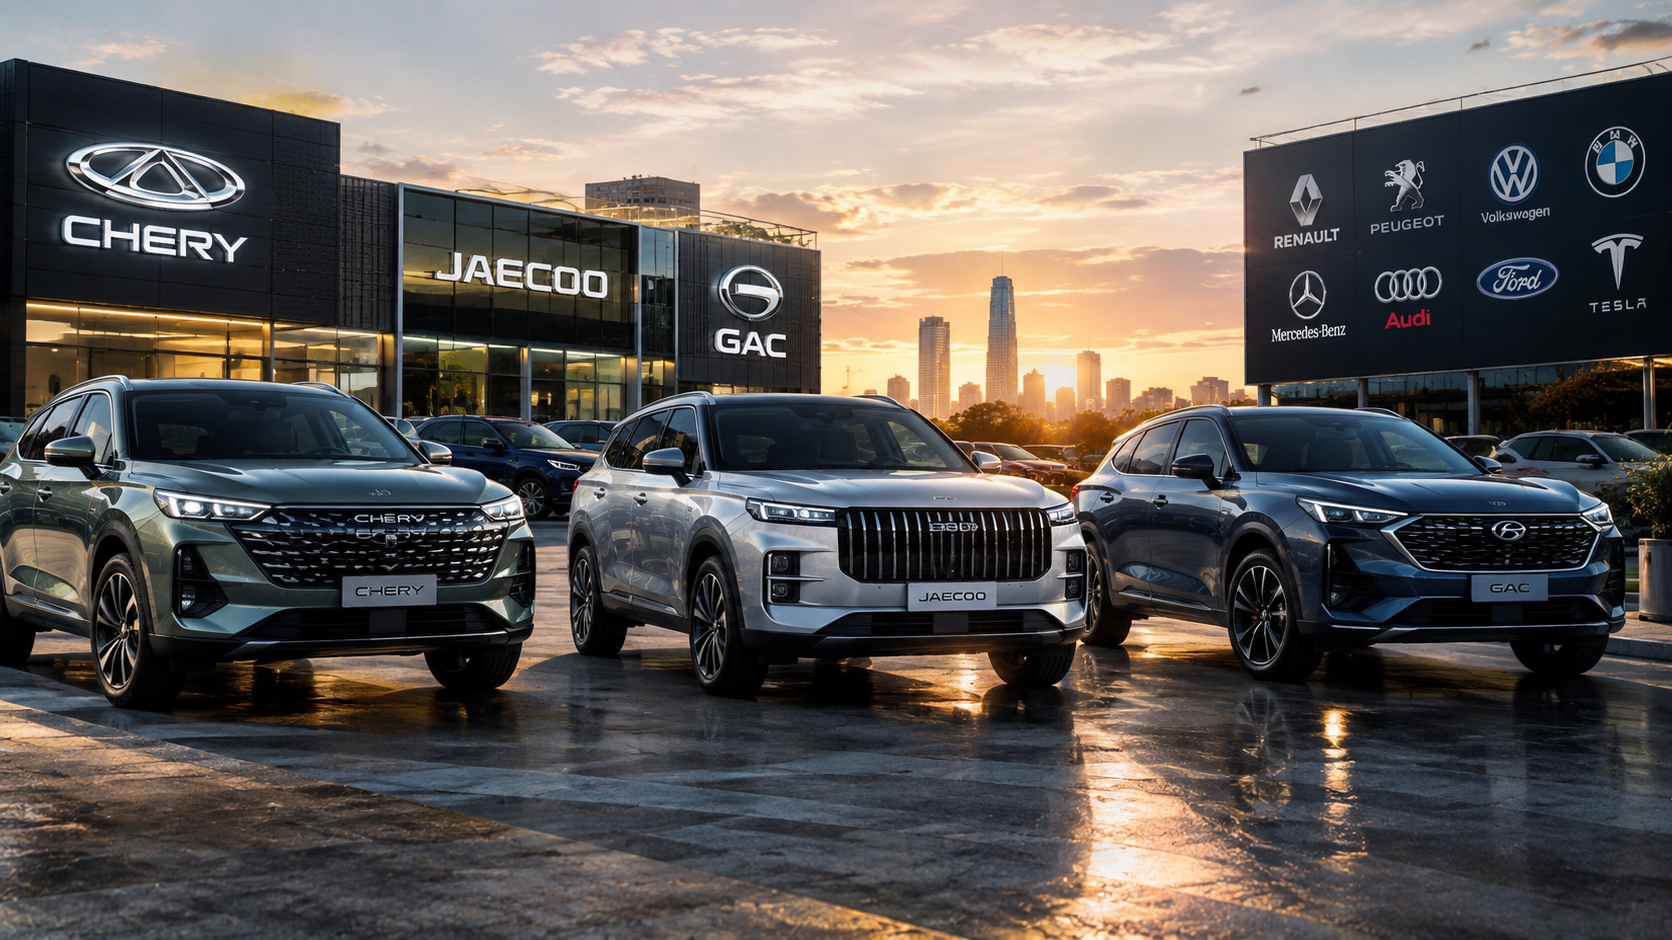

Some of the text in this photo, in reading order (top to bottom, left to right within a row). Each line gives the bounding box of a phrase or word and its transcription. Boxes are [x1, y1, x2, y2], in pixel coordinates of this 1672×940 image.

[1370, 215, 1445, 234] PEUGEOT
[62, 215, 248, 263] CHERY
[1274, 228, 1340, 249] RENAULT
[436, 251, 608, 299] JAECOO
[1492, 264, 1543, 294] Ford
[1589, 297, 1647, 313] TESLA
[1385, 309, 1431, 330] Audi
[1271, 324, 1346, 342] Mercedes-Benz
[714, 328, 787, 359] GAC
[355, 585, 424, 597] CHERY
[918, 592, 987, 603] JAECOO
[1489, 583, 1530, 594] GAC
